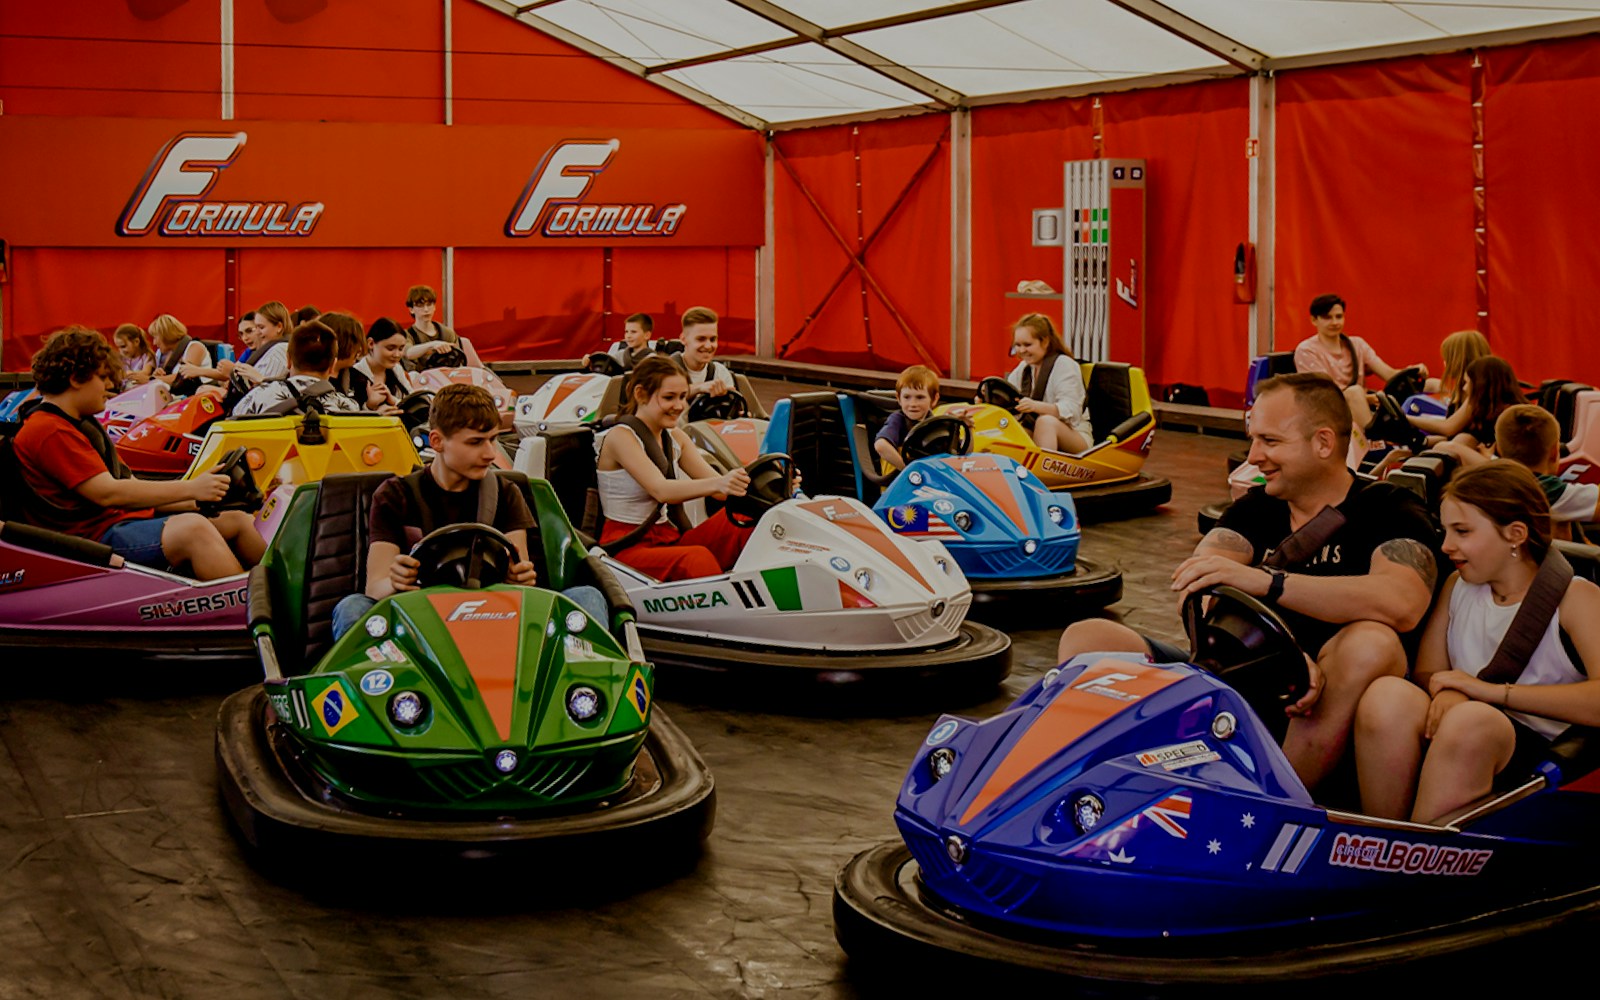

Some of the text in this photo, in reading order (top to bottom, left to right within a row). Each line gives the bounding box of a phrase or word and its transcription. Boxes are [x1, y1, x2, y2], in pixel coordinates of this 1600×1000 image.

[118, 131, 325, 236] FORMULA
[506, 138, 687, 237] FORMULA
[446, 599, 518, 622] FORMULA
[643, 591, 728, 613] MONZA
[367, 673, 388, 690] 12
[1329, 833, 1492, 875] MELBOURNE
